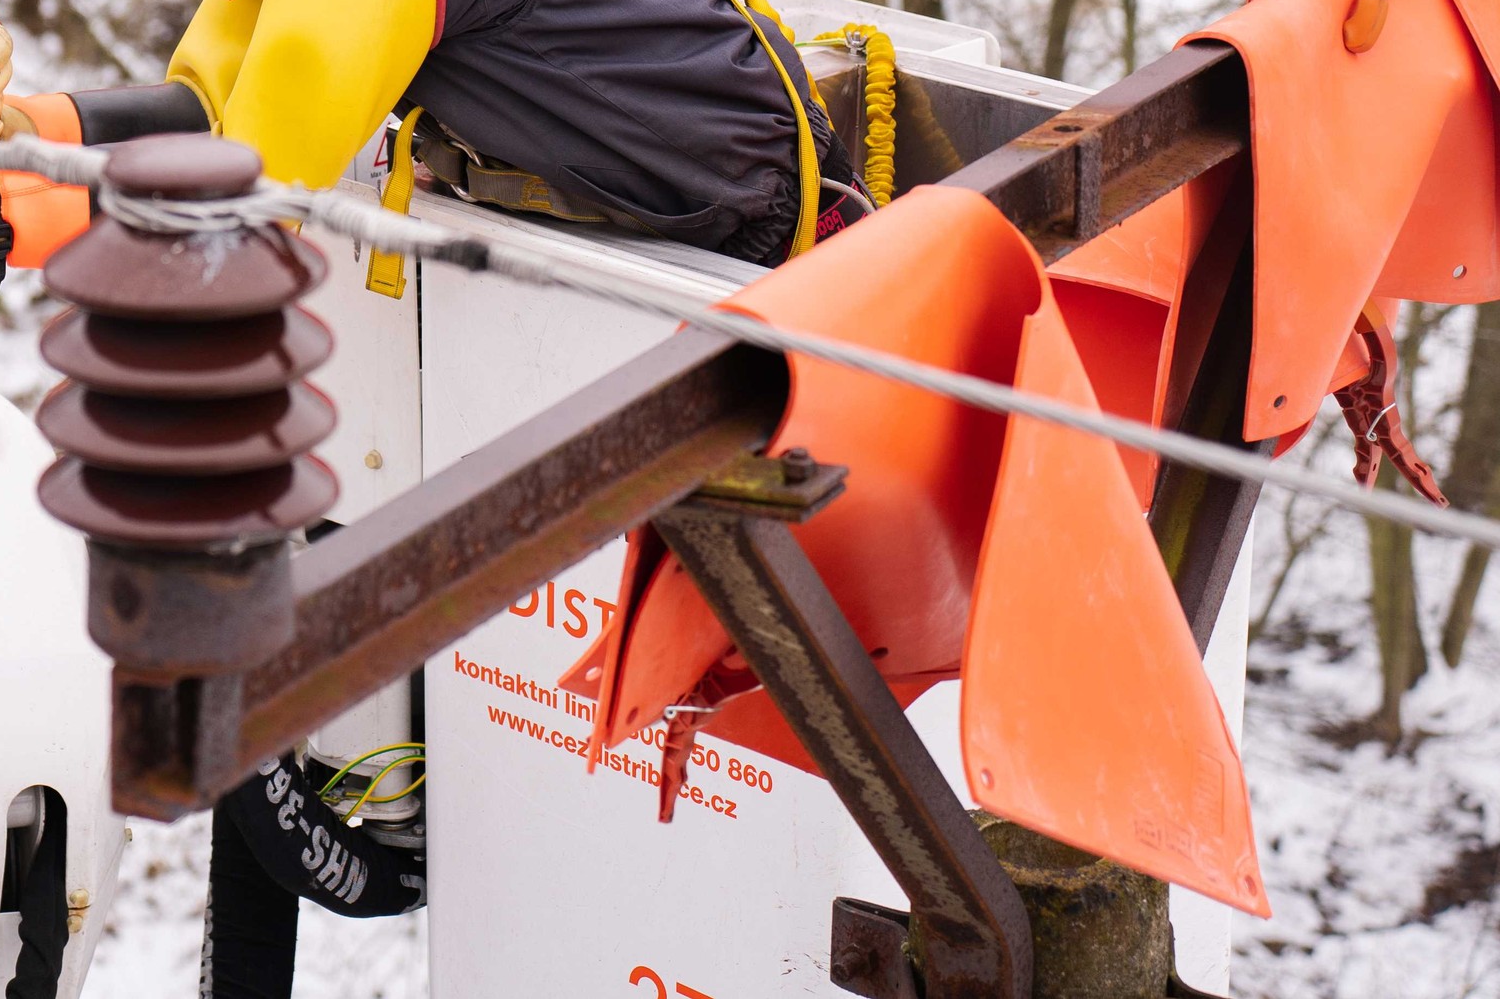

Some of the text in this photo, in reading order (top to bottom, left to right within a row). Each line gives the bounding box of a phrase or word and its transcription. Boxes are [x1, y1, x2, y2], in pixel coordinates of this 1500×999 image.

[454, 651, 559, 709] kontaktní
[727, 758, 773, 794] 860
[488, 705, 737, 819] www.cezistribce.cz
